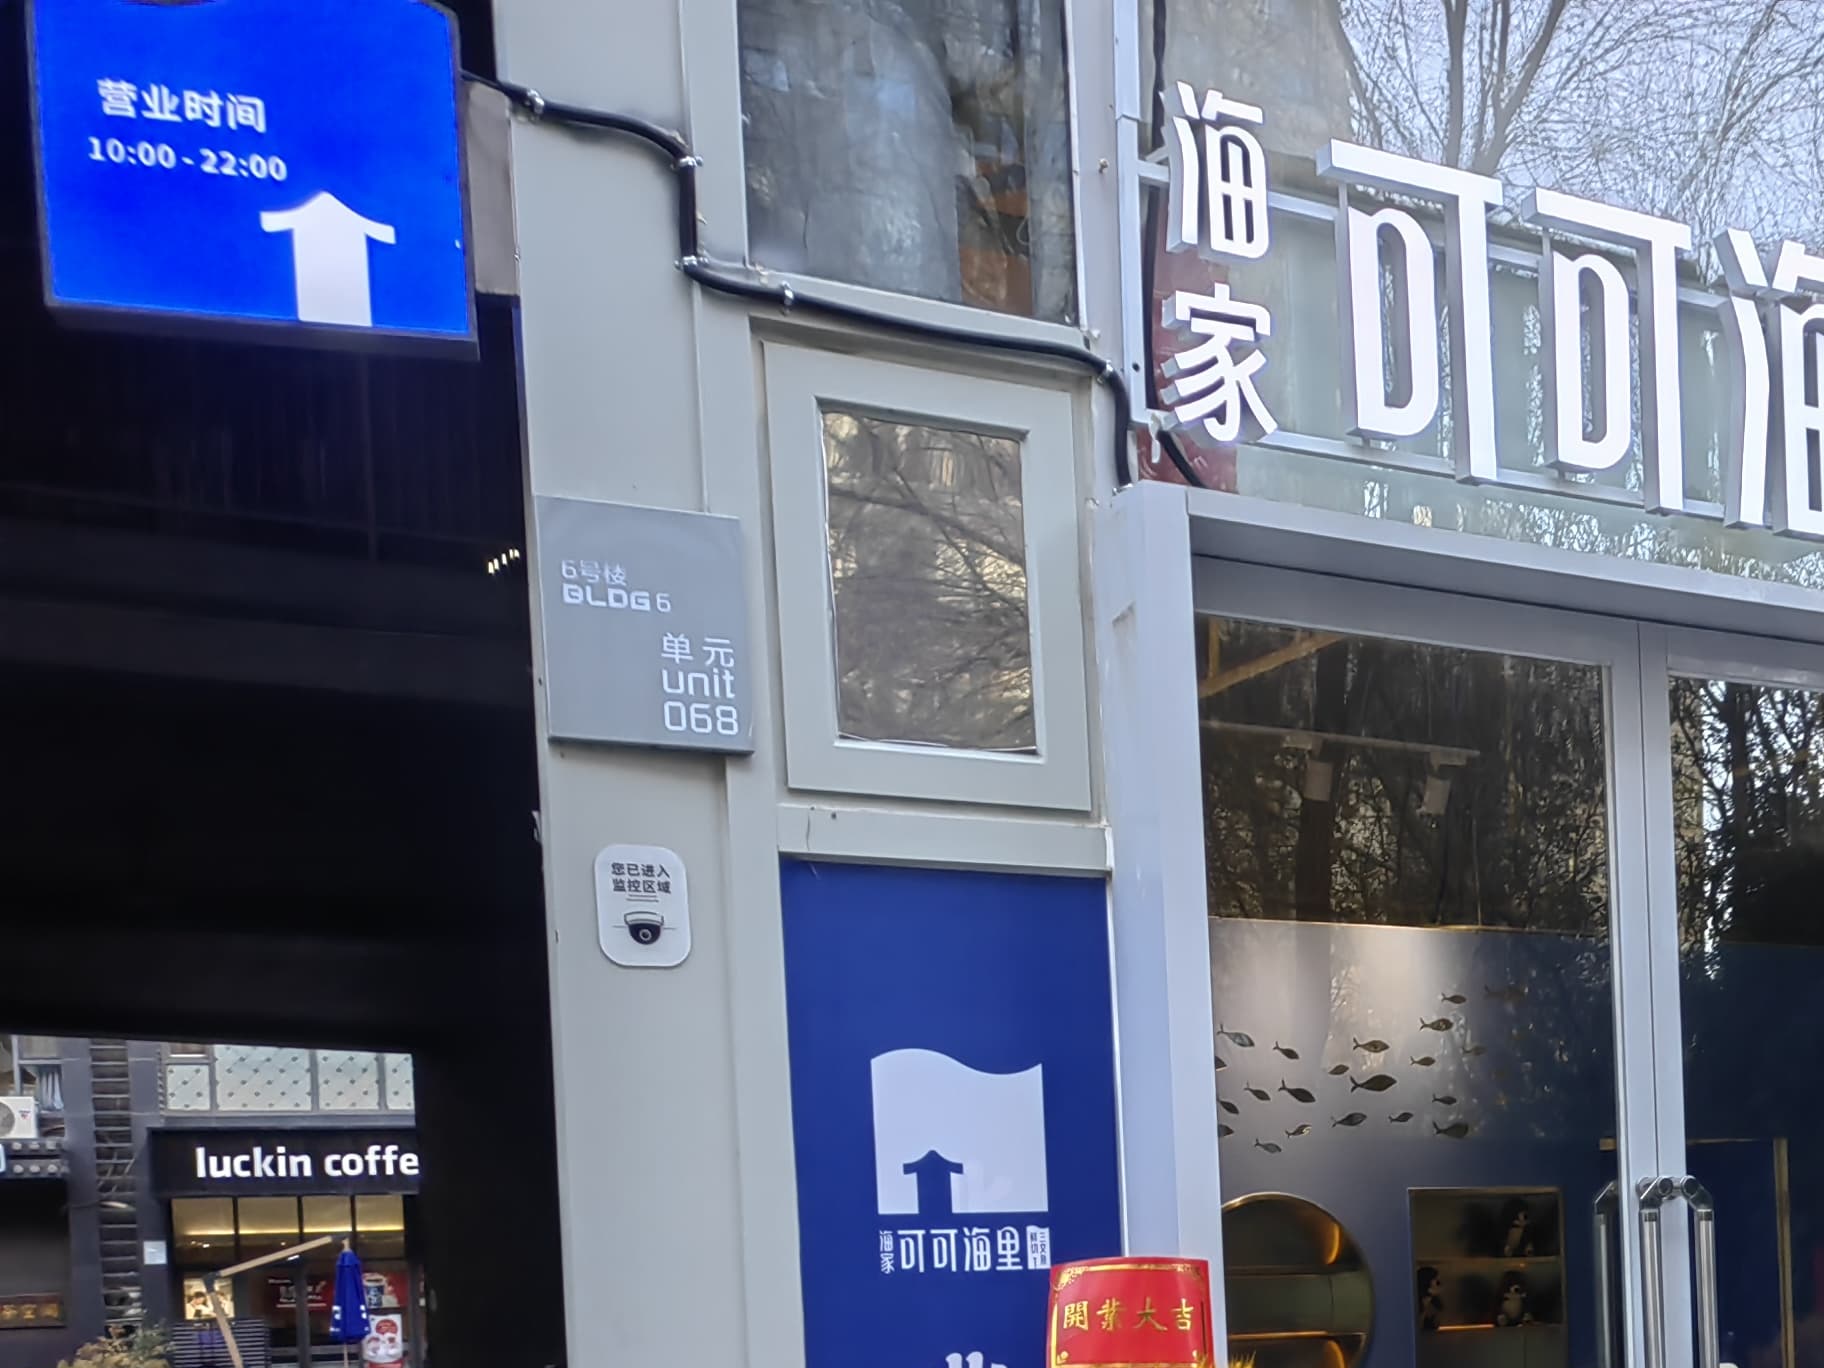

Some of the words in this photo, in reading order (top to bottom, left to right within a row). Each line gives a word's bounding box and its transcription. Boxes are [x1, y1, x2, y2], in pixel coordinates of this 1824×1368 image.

[96, 77, 267, 133] 营业时间
[1170, 80, 1278, 442] 海家
[561, 560, 627, 586] 6号楼
[563, 583, 650, 611] BLDG
[656, 592, 672, 613] 6
[661, 632, 735, 668] 单元
[662, 668, 735, 699] unit
[664, 701, 739, 735] 068
[611, 862, 670, 878] 您已进入
[612, 879, 671, 894] 监控区域
[195, 1146, 312, 1178] luckin
[897, 1226, 1023, 1273] 可可海里
